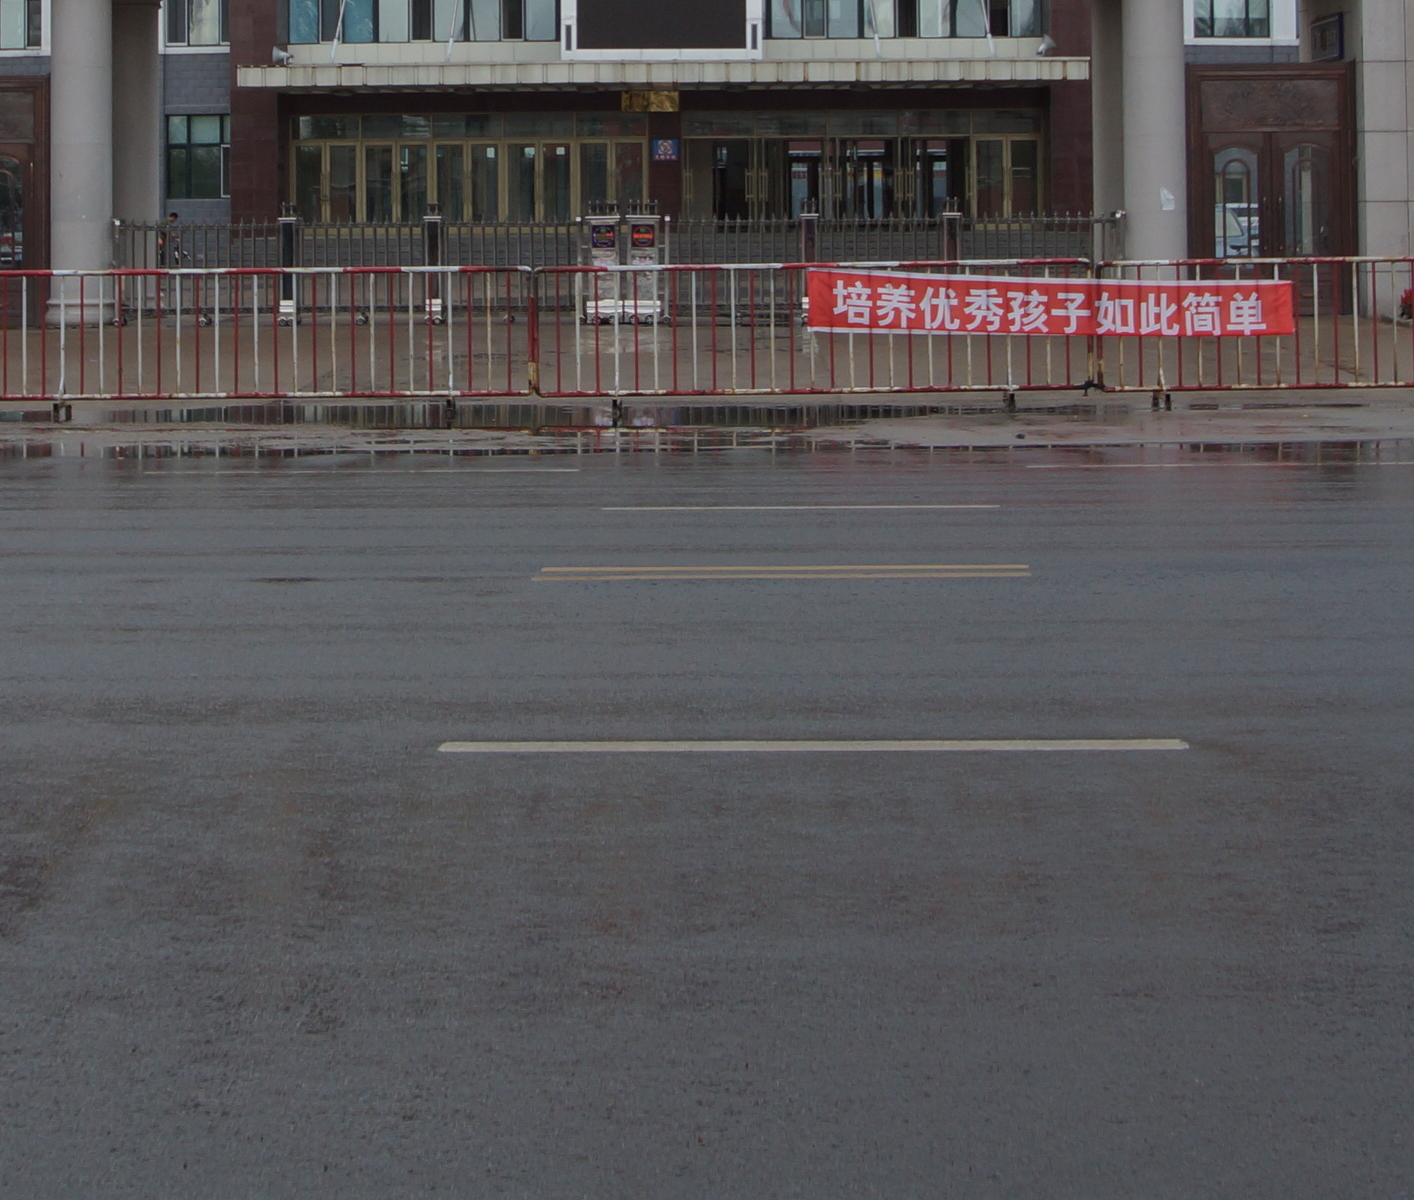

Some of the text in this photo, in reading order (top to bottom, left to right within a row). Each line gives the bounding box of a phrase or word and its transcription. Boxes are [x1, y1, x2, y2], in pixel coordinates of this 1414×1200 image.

[832, 280, 1267, 336] 培养优秀孩子如此简单
